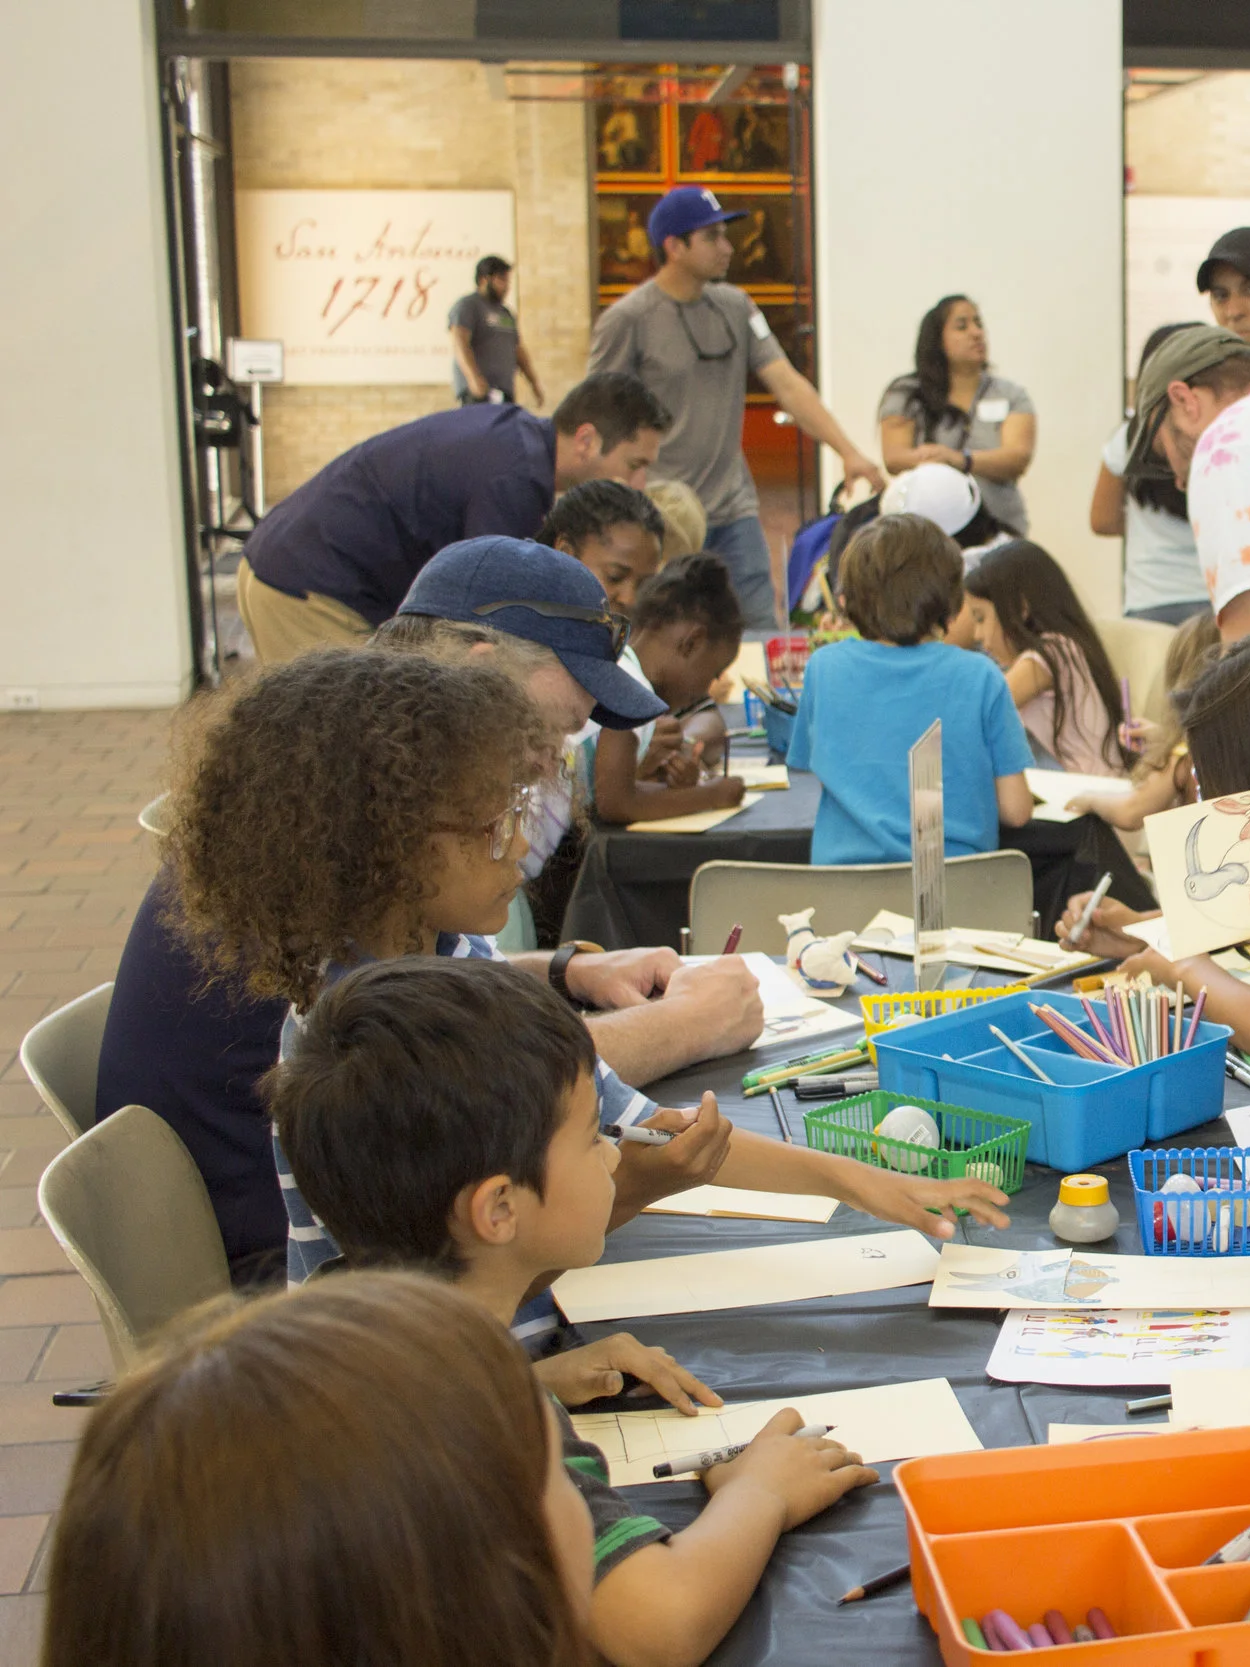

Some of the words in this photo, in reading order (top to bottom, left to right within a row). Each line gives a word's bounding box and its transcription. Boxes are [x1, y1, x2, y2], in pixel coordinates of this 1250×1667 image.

[275, 218, 338, 261] San
[354, 220, 481, 263] Antonio
[320, 266, 439, 337] 1718
